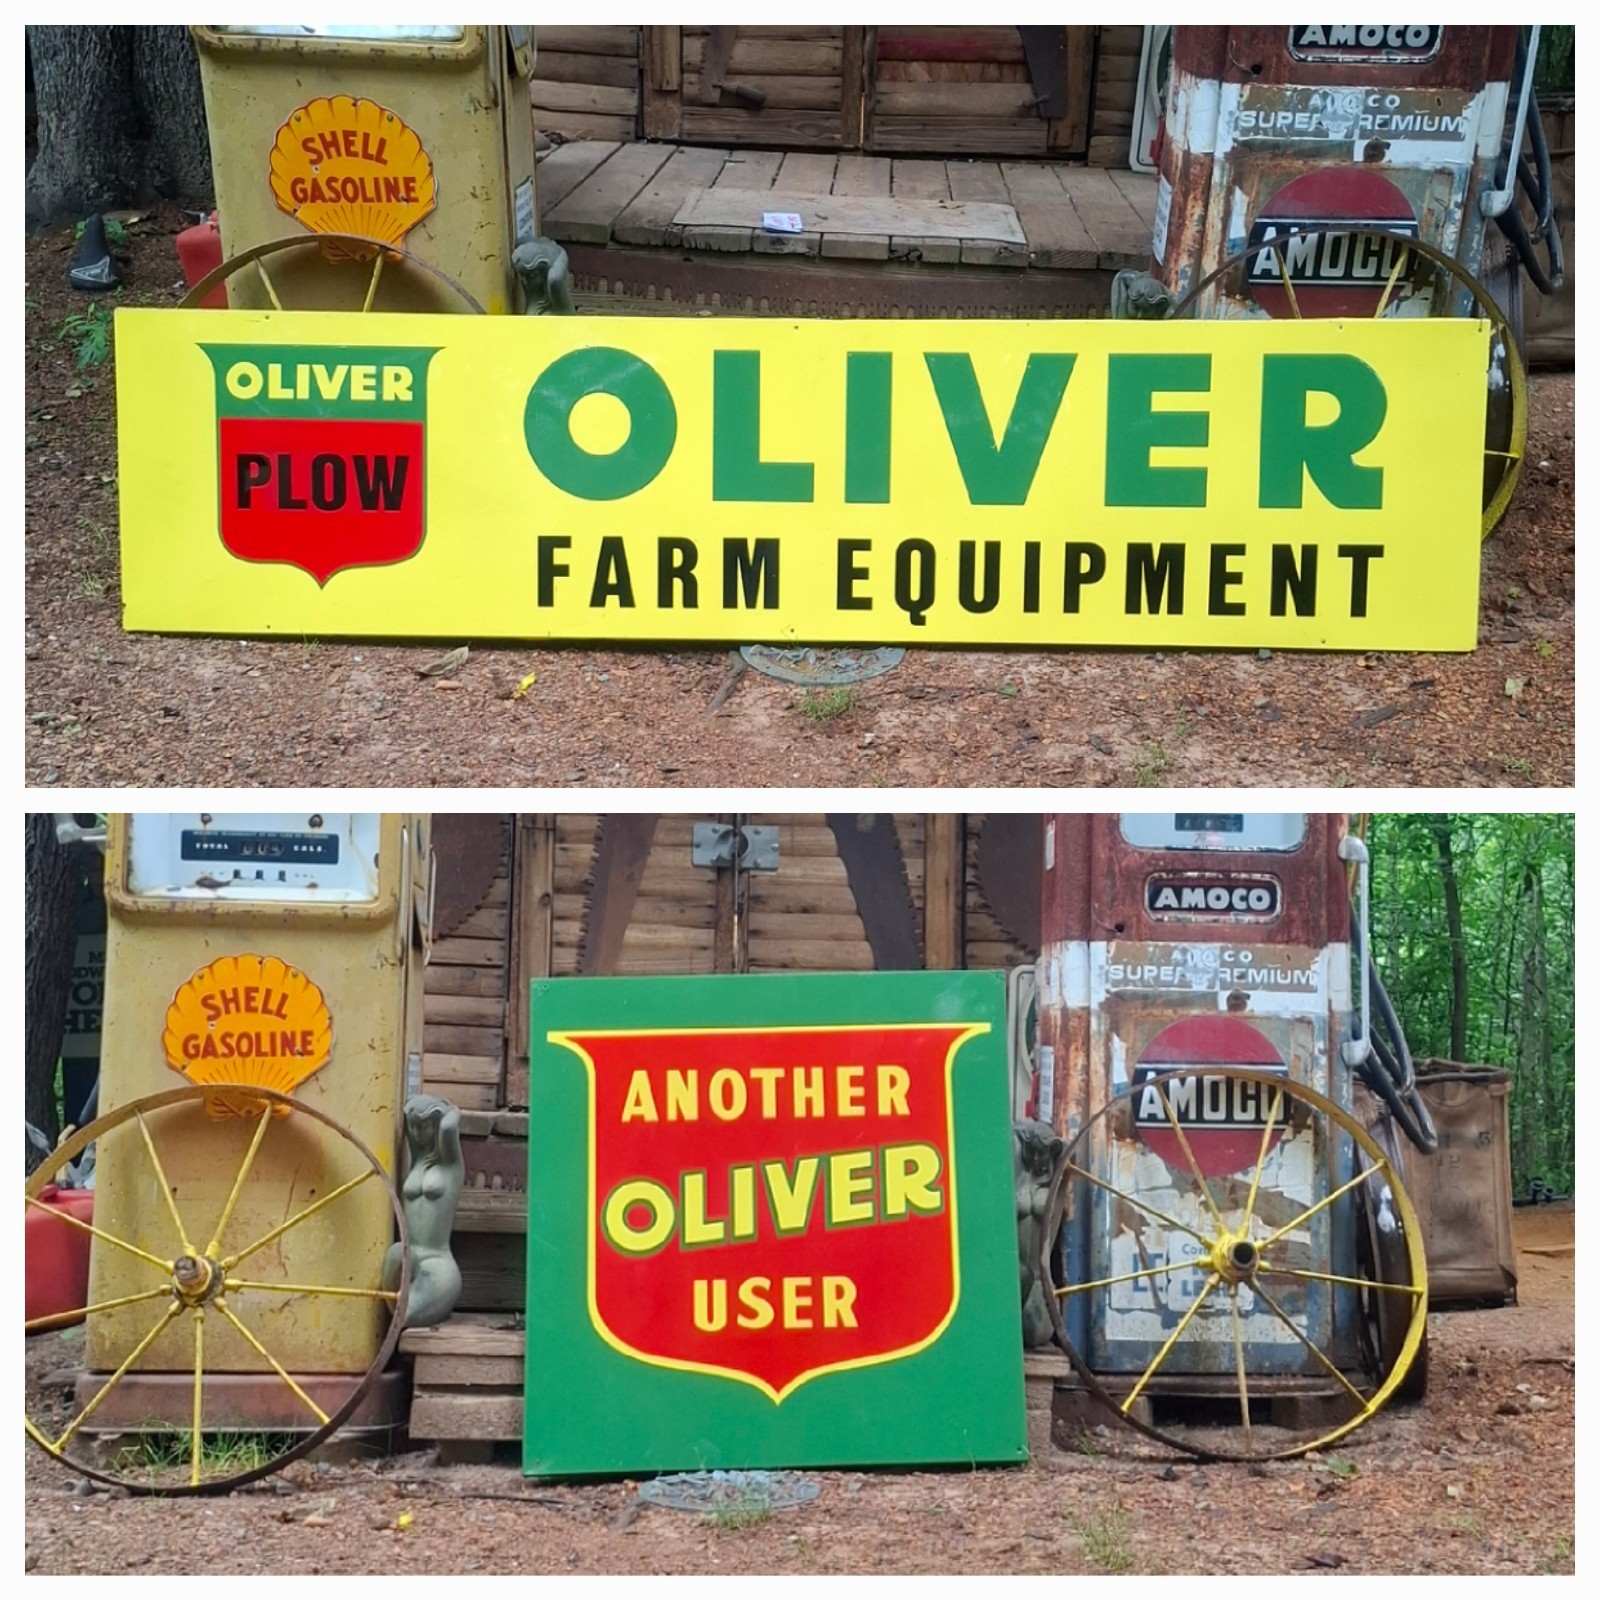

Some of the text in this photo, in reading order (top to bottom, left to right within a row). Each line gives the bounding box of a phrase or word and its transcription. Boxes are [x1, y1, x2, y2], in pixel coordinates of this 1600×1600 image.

[1298, 25, 1430, 48] AMOCO
[1352, 114, 1465, 133] REMIUM
[301, 129, 389, 167] SHELL
[290, 176, 420, 205] GASOLINE
[1252, 226, 1413, 278] AMOCO
[226, 361, 414, 401] OLIVER
[524, 346, 1388, 509] OLIVER
[236, 453, 410, 512] PLOW
[536, 535, 1385, 627] FARM EQUIPMENT
[1153, 887, 1271, 910] AMOCO
[1212, 967, 1315, 985] REMIUM
[200, 986, 290, 1022] SHELL
[182, 1030, 315, 1060] GASOLINE
[621, 1064, 911, 1123] ANOTHER
[1138, 1070, 1285, 1122] AMOCO
[603, 1141, 944, 1256] OLIVER
[692, 1275, 859, 1332] USER
